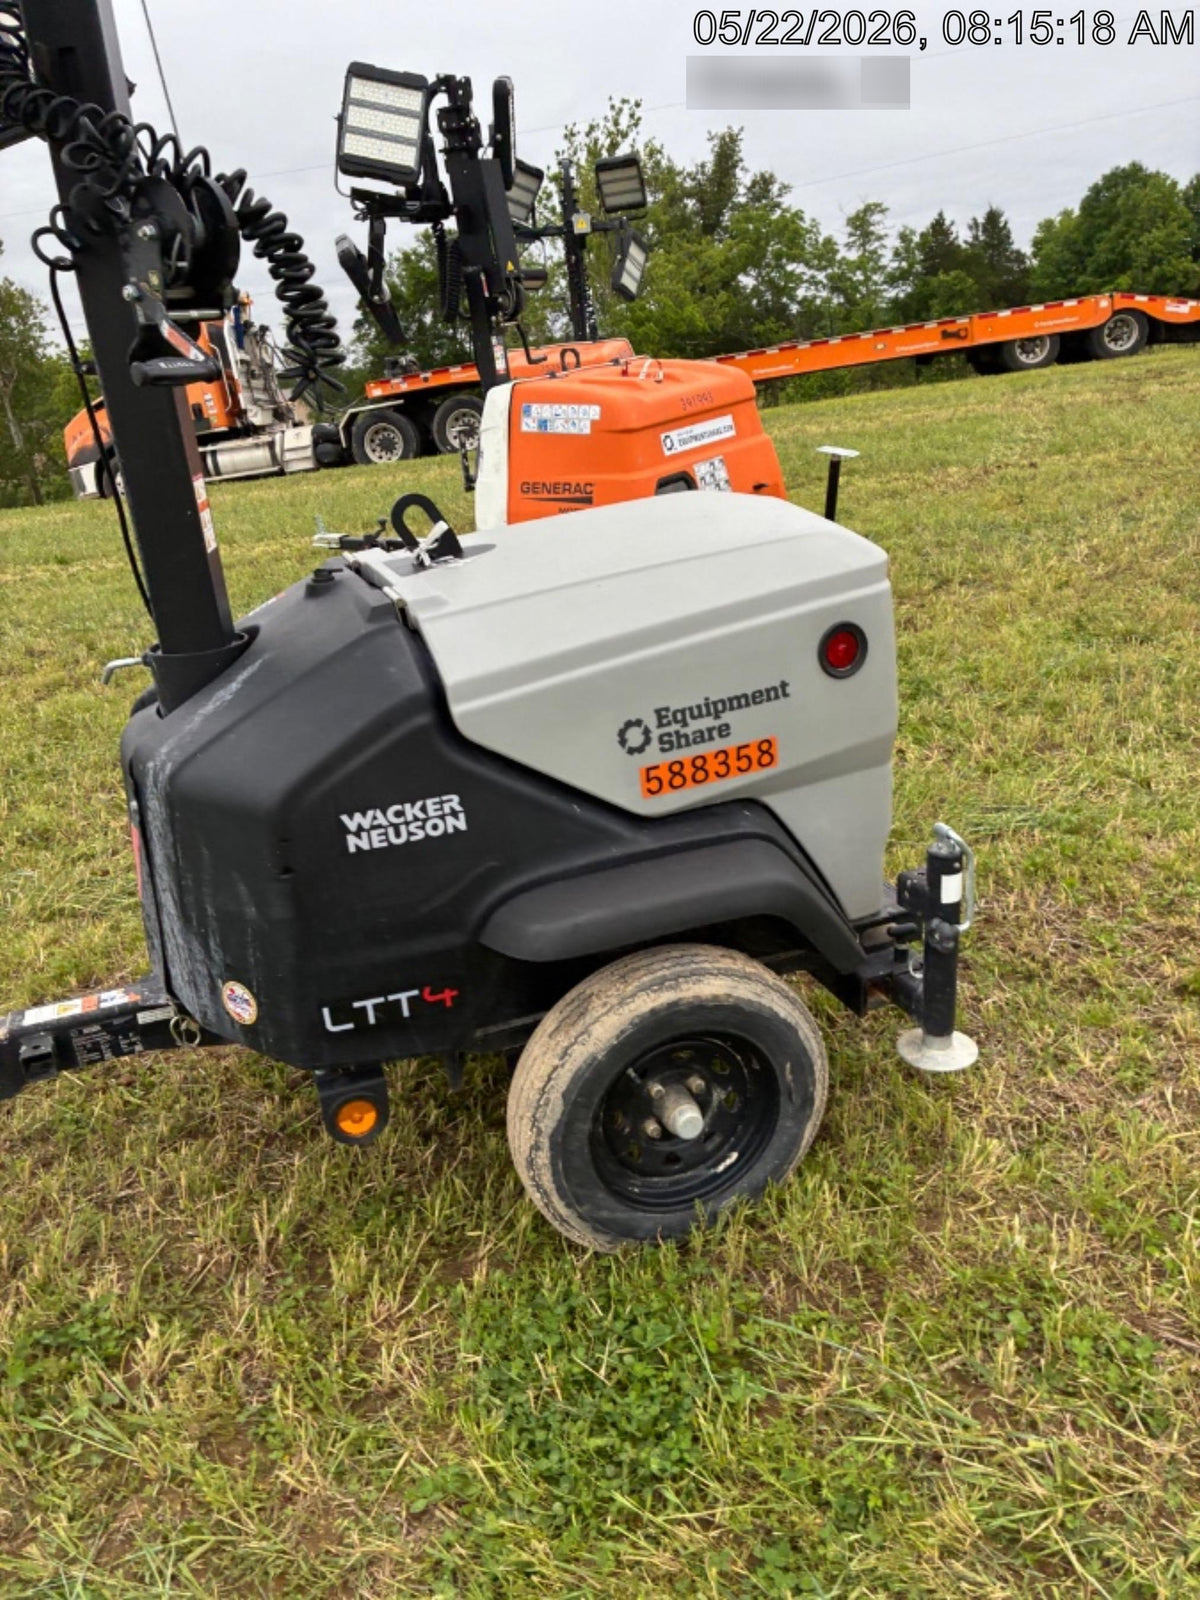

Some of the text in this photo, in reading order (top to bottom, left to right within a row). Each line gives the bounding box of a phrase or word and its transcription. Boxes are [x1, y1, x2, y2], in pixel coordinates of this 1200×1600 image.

[520, 481, 594, 495] GENERAC
[654, 680, 790, 729] Equipment
[658, 722, 731, 753] Share
[646, 739, 774, 795] 588358
[339, 794, 464, 832] WACKER
[346, 811, 467, 853] NEUSON
[322, 986, 459, 1032] LTT4
